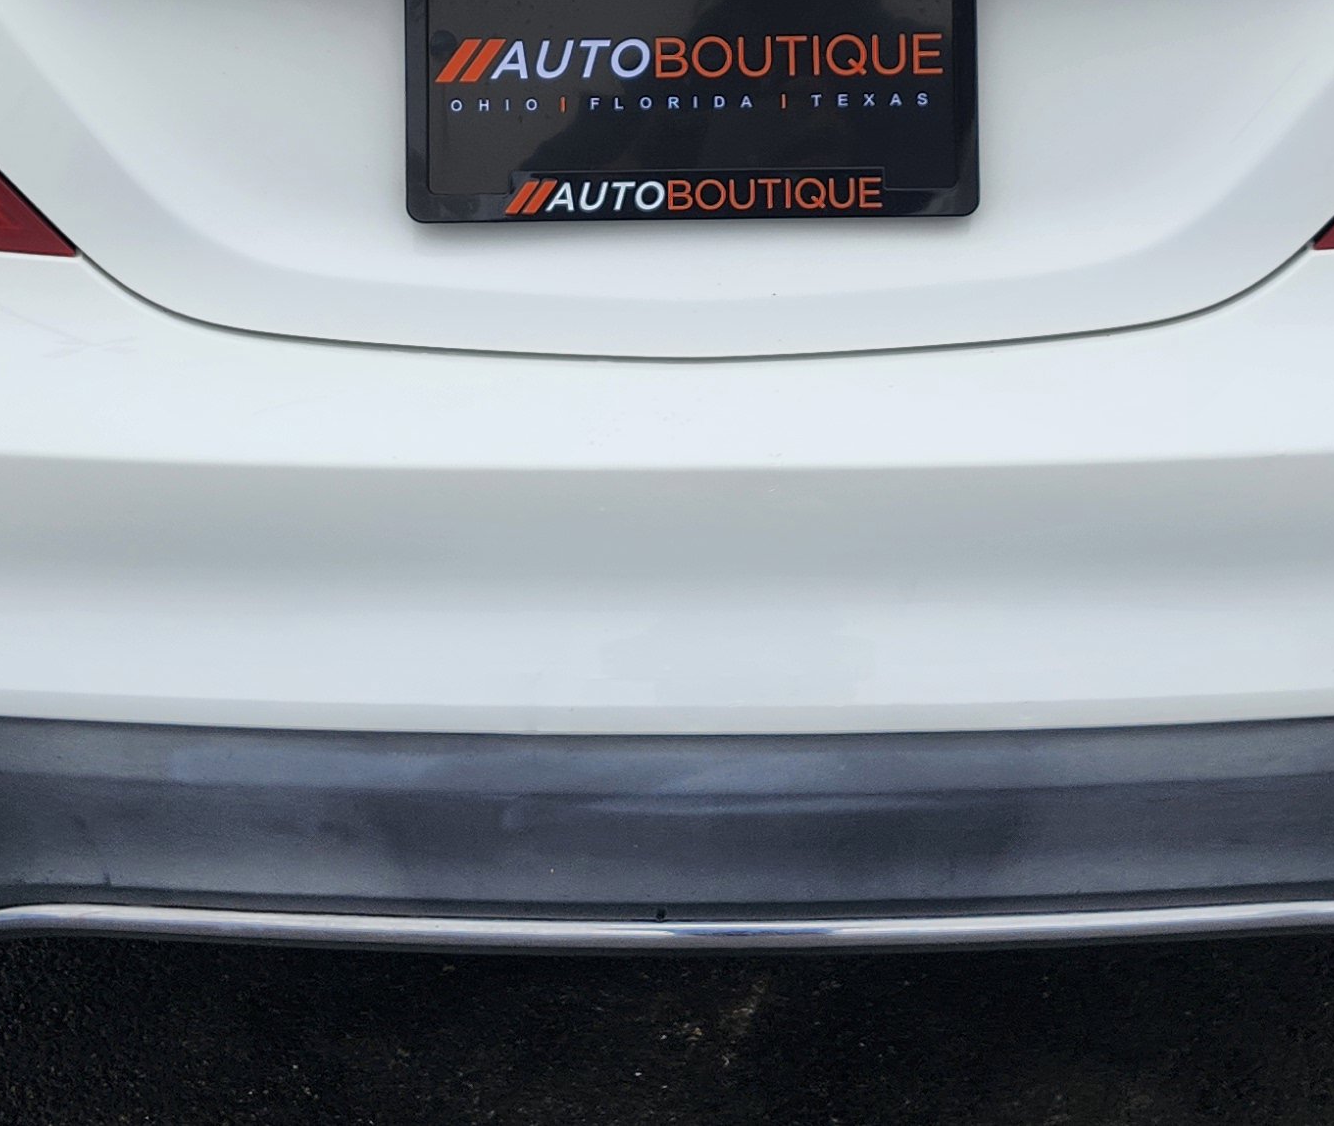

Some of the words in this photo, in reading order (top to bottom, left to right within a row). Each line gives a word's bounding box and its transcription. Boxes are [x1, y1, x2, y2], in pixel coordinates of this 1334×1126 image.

[491, 34, 943, 80] AUTOBOUTIQUE
[451, 98, 538, 112] OHIO
[590, 95, 753, 110] FLORIDA
[811, 92, 929, 108] TEXAS
[545, 176, 883, 213] AUTOBOUTIQUE
